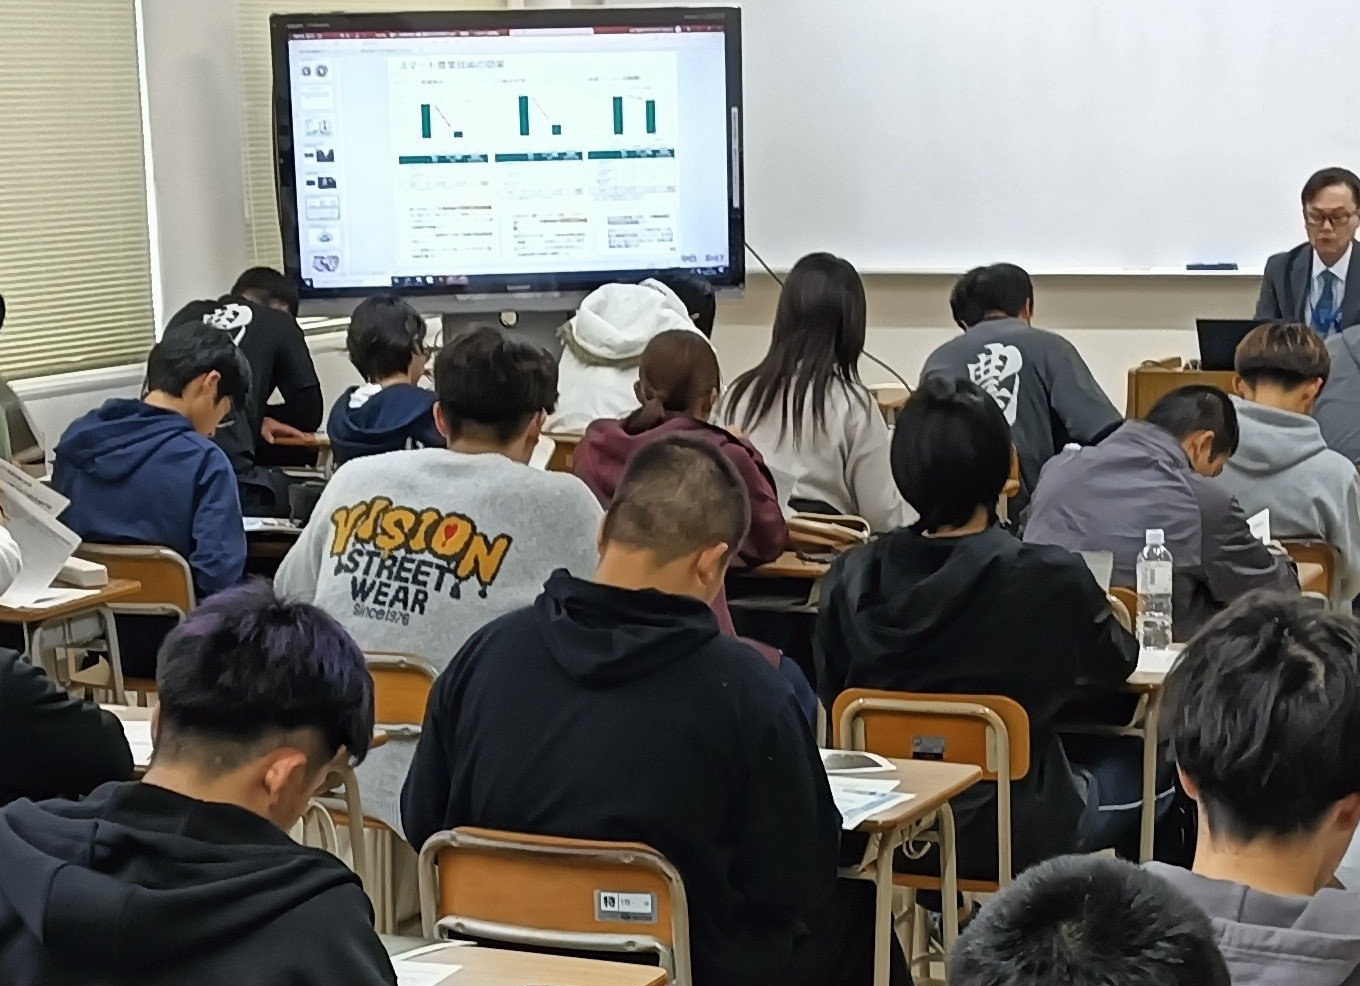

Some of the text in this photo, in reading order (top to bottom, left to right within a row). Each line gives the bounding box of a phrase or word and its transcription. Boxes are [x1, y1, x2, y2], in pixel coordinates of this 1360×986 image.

[330, 495, 512, 586] VISION
[345, 549, 454, 592] STREET
[351, 576, 429, 615] WEAR
